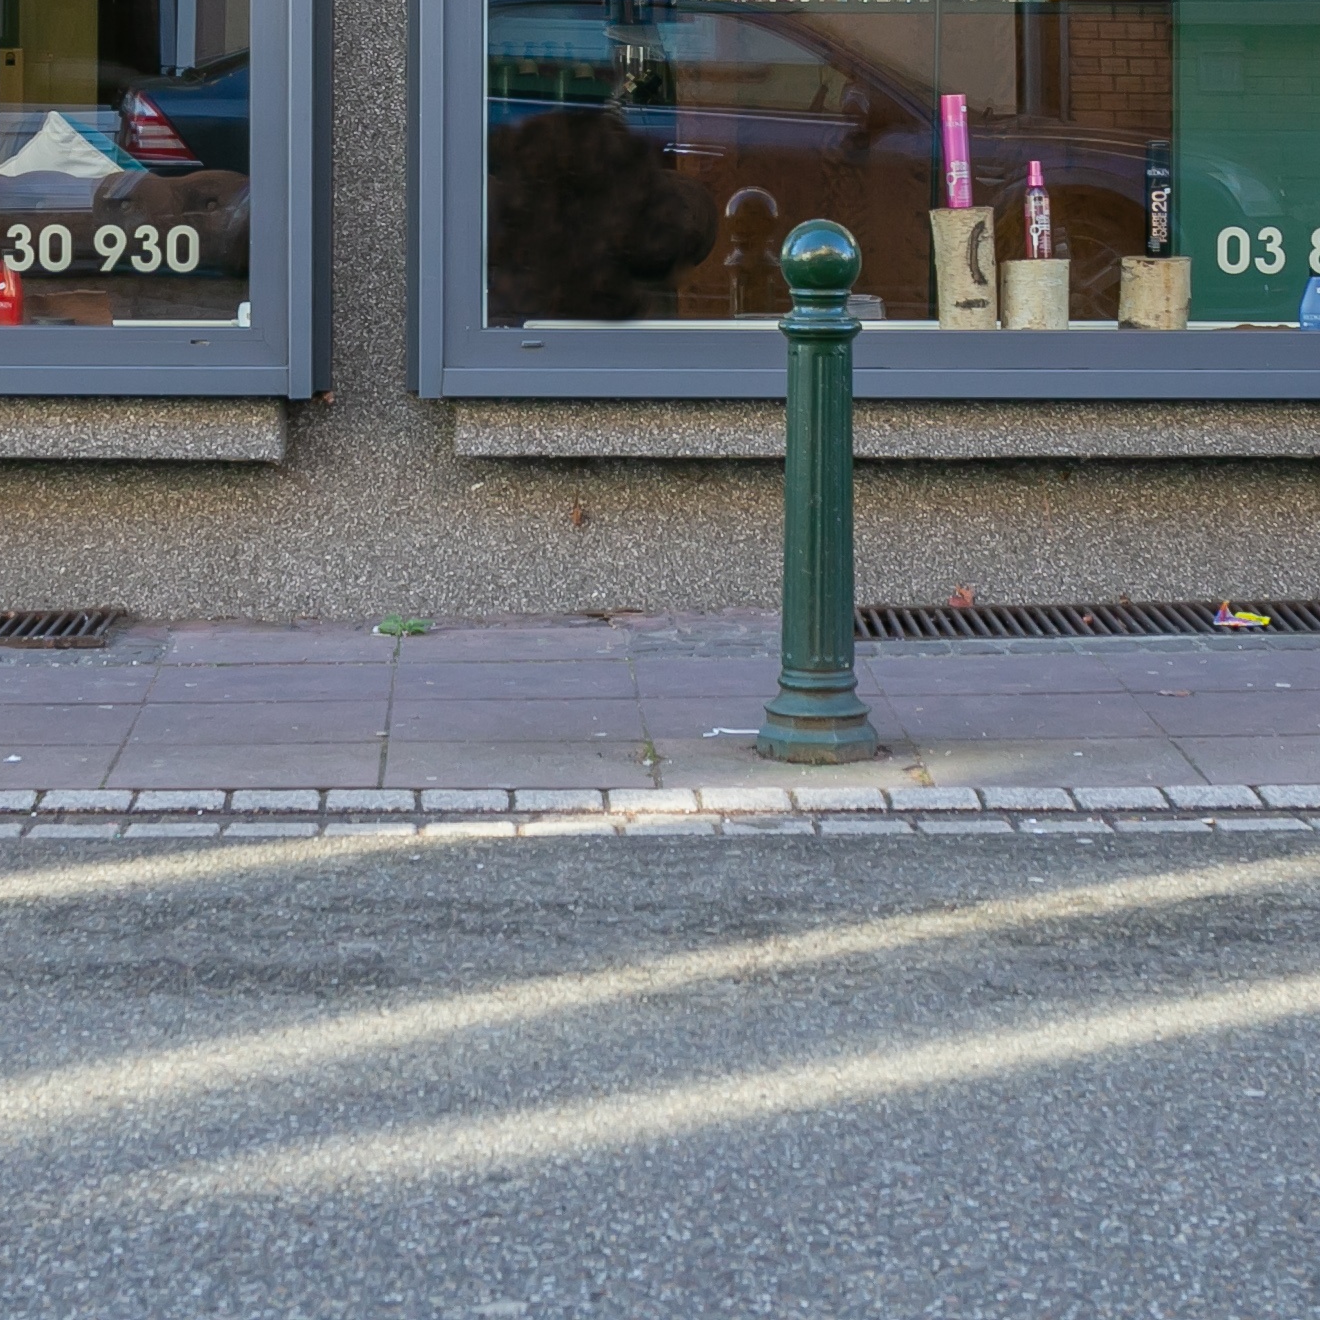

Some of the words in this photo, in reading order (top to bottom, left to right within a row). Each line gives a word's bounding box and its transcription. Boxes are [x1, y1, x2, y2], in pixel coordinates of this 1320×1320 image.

[1151, 190, 1168, 212] 20
[93, 224, 201, 273] 930
[1216, 226, 1286, 275] 03
